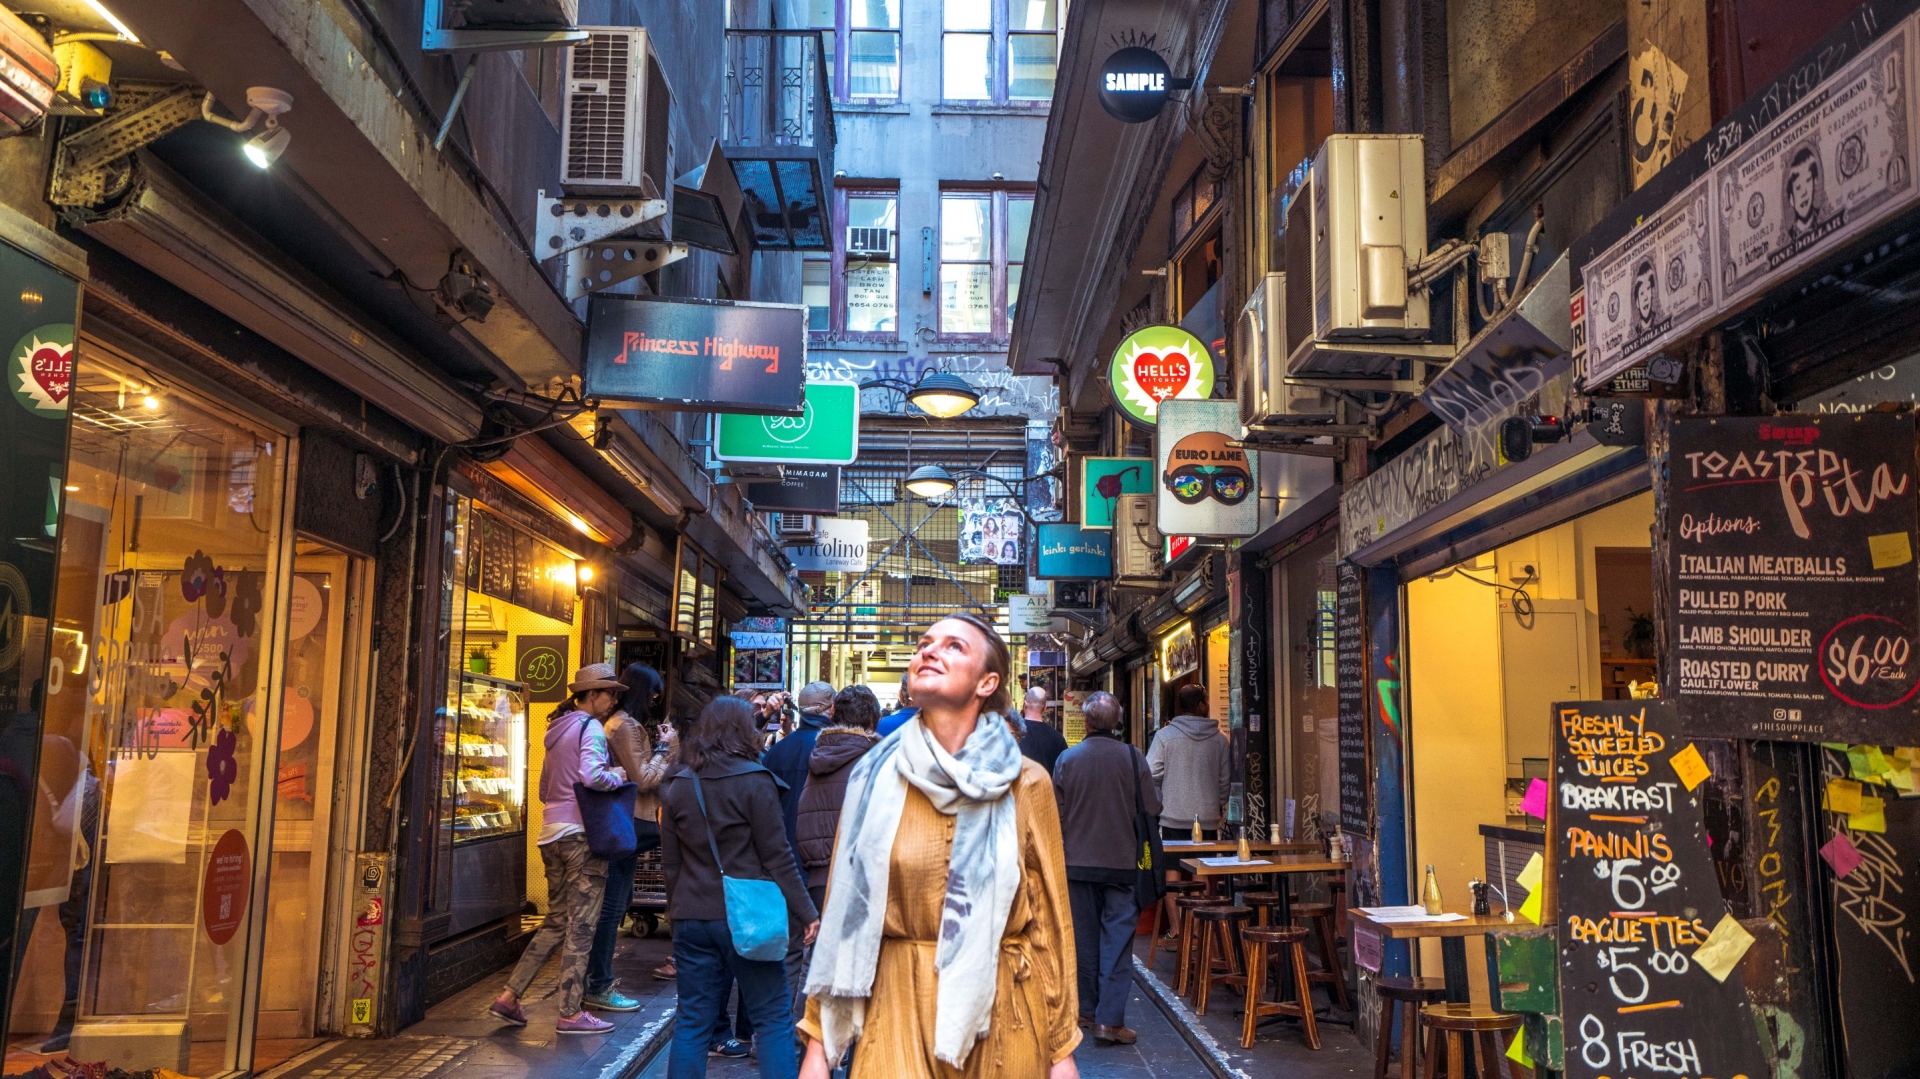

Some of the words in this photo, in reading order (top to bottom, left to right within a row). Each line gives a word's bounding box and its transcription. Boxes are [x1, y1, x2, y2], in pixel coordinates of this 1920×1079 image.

[1106, 73, 1164, 91] SAMPLE
[1755, 141, 1781, 169] UNITED
[1782, 124, 1810, 148] STATES
[1810, 115, 1821, 131] OF
[1632, 243, 1649, 259] STATES
[1771, 246, 1795, 266] ONE
[1796, 218, 1842, 251] DOLLAR
[1624, 341, 1640, 355] ONE
[1640, 321, 1671, 347] DOLLAR
[614, 331, 698, 364] Princess
[704, 336, 779, 374] Highway
[1138, 363, 1187, 377] HELL'S
[1175, 449, 1209, 460] EURO
[1211, 450, 1242, 461] LANE
[1685, 448, 1841, 479] TOASTED
[818, 529, 829, 539] afe
[1679, 512, 1761, 543] Options:
[1042, 542, 1066, 556] kinki
[1680, 554, 1745, 574] ITALIAN
[1749, 555, 1847, 576] MEATBALLS
[1680, 589, 1740, 609] PULLED
[1744, 590, 1787, 610] PORK
[735, 635, 783, 646] HAVN
[1680, 624, 1724, 644] LAMB
[1729, 625, 1811, 647] SHOULDER
[1680, 658, 1750, 680] ROASTED
[1756, 660, 1809, 683] CURRY
[1827, 635, 1910, 686] $6.00
[1680, 678, 1759, 691] CAULIFLOWER
[1560, 707, 1646, 738] FRESHLY
[1751, 721, 1825, 734] @THESOUPPLACE
[1568, 731, 1665, 756] SQUEEZED
[1577, 754, 1649, 777] JUICES
[1560, 782, 1678, 813] BREAKFAST
[1567, 827, 1673, 863] PANINIS
[1593, 858, 1681, 910] $6.00
[1568, 915, 1712, 950] BAGUETTES
[1597, 946, 1689, 1003] $5.00
[1580, 1013, 1611, 1069] 8
[1617, 1031, 1702, 1076] FRESH
